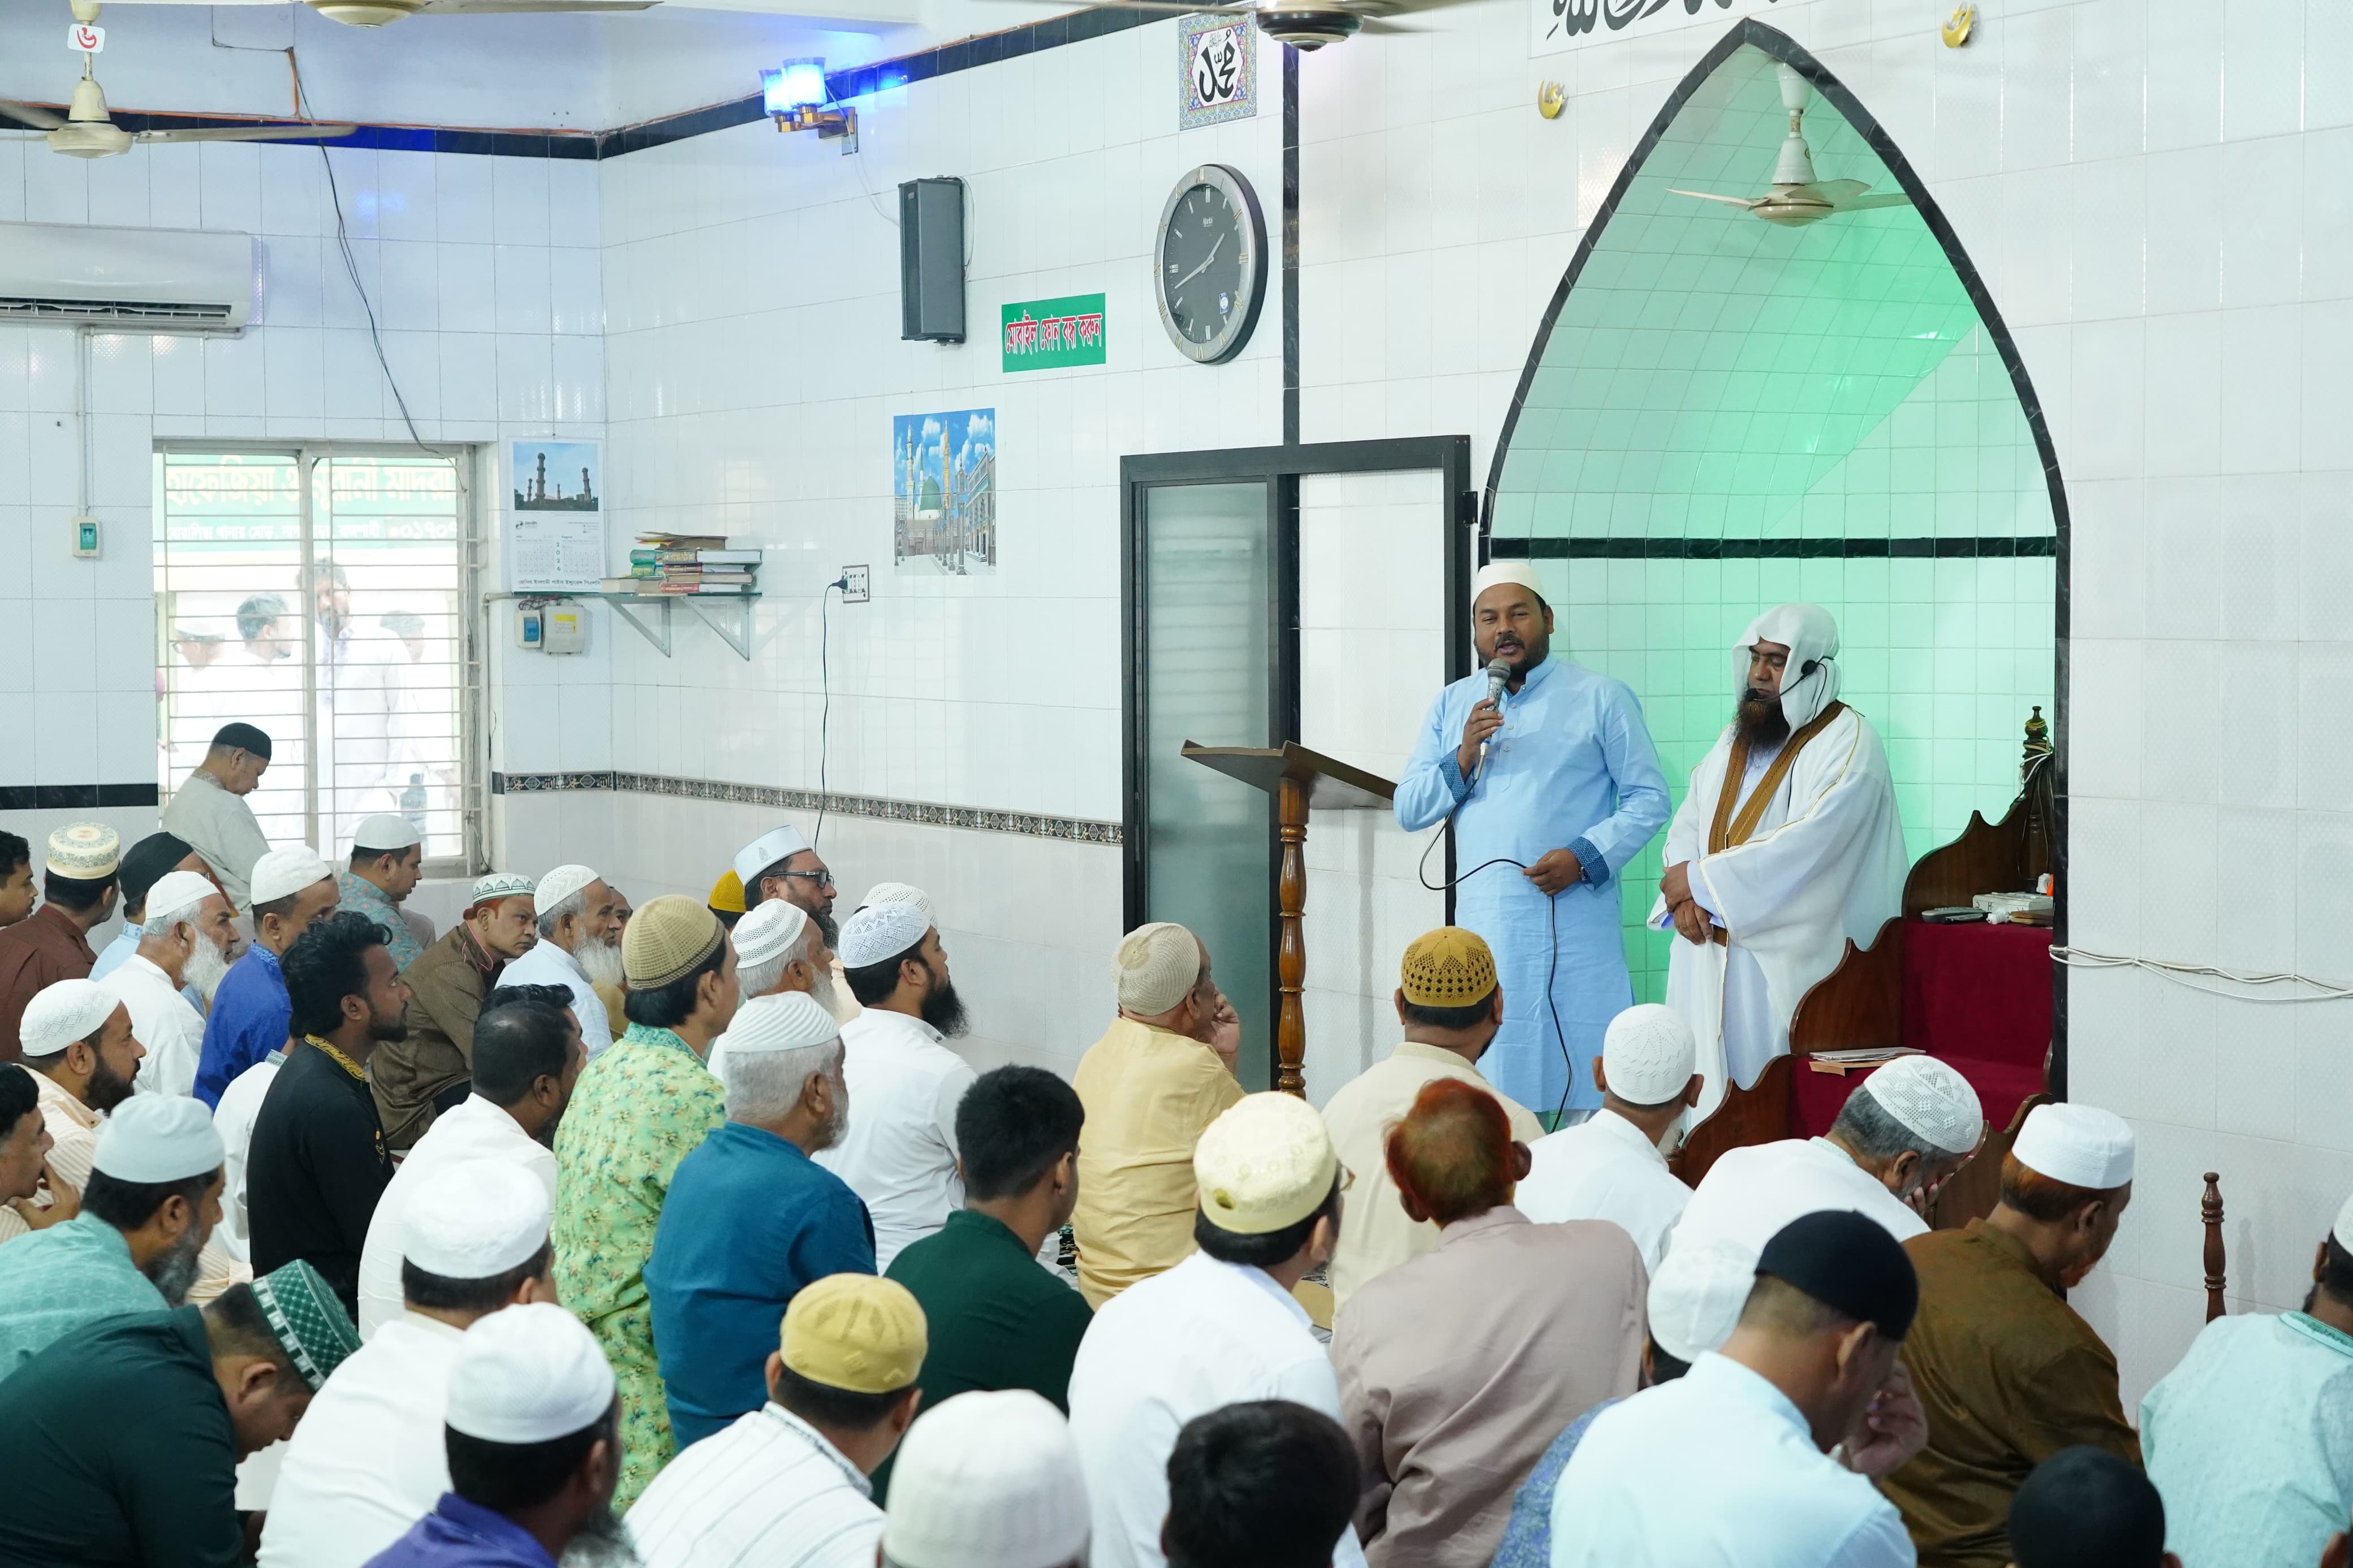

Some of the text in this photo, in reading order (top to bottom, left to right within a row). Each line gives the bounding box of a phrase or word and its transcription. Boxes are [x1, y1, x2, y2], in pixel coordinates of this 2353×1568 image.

[1005, 309, 1103, 356] মোবাইল ফোন বন্ধ করুন
[382, 466, 457, 502] মাদরা
